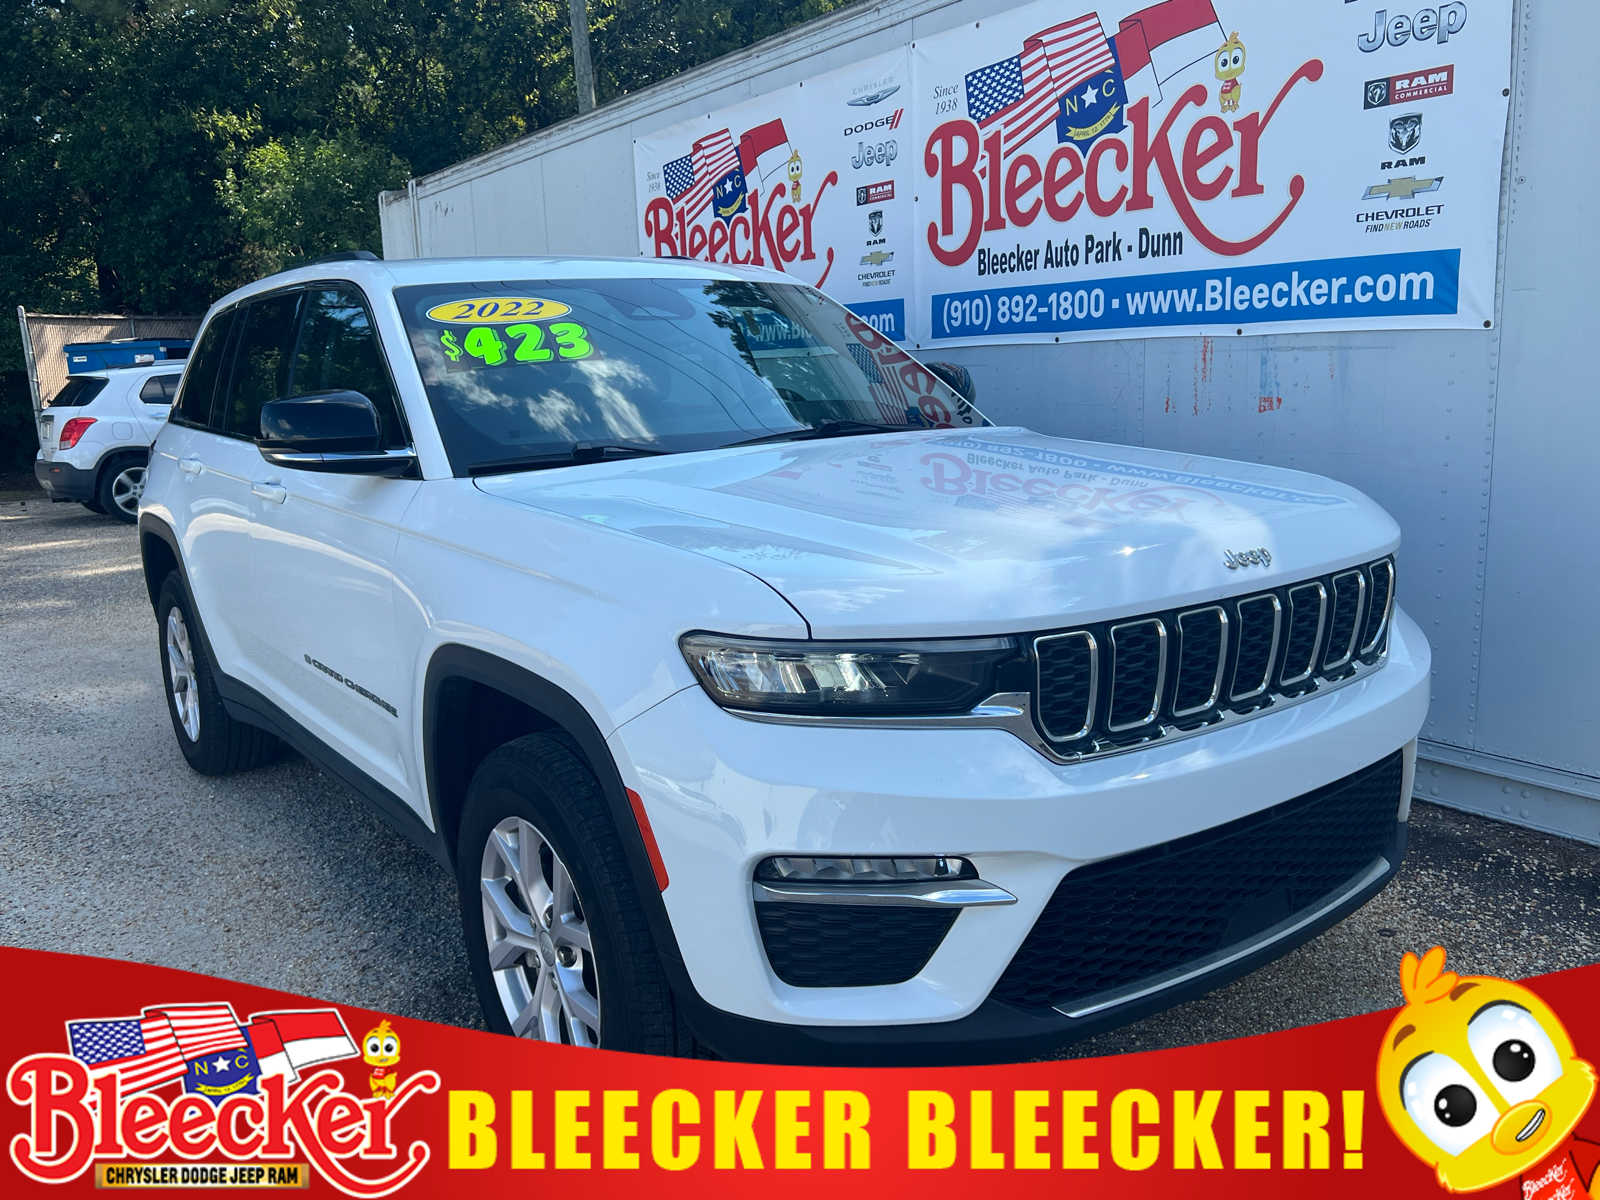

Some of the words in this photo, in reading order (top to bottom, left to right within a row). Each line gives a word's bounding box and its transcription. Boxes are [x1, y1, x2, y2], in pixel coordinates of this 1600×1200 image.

[1357, 0, 1468, 53] Jeep
[1395, 71, 1449, 91] RAM
[933, 83, 959, 99] Since
[1394, 86, 1448, 101] COMMERCIAL
[935, 98, 958, 115] 1938
[843, 114, 896, 136] DODGE
[850, 139, 898, 170] Jeep
[924, 58, 1324, 267] Bleecker
[1380, 156, 1426, 170] RAM
[869, 184, 892, 195] RAM
[1356, 204, 1445, 223] CHEVROLET
[866, 237, 887, 247] RAM
[977, 244, 1040, 276] Bleecker
[1043, 239, 1080, 270] Auto
[1084, 231, 1122, 265] Park
[1138, 227, 1183, 260] Dunn
[857, 269, 896, 281] CHEVROLET
[452, 301, 546, 320] 2022
[943, 294, 992, 334] (910)
[997, 288, 1105, 325] 892-1800
[1126, 269, 1435, 316] www.Bleecker.com
[440, 322, 594, 366] $423
[1223, 547, 1273, 570] Jeep
